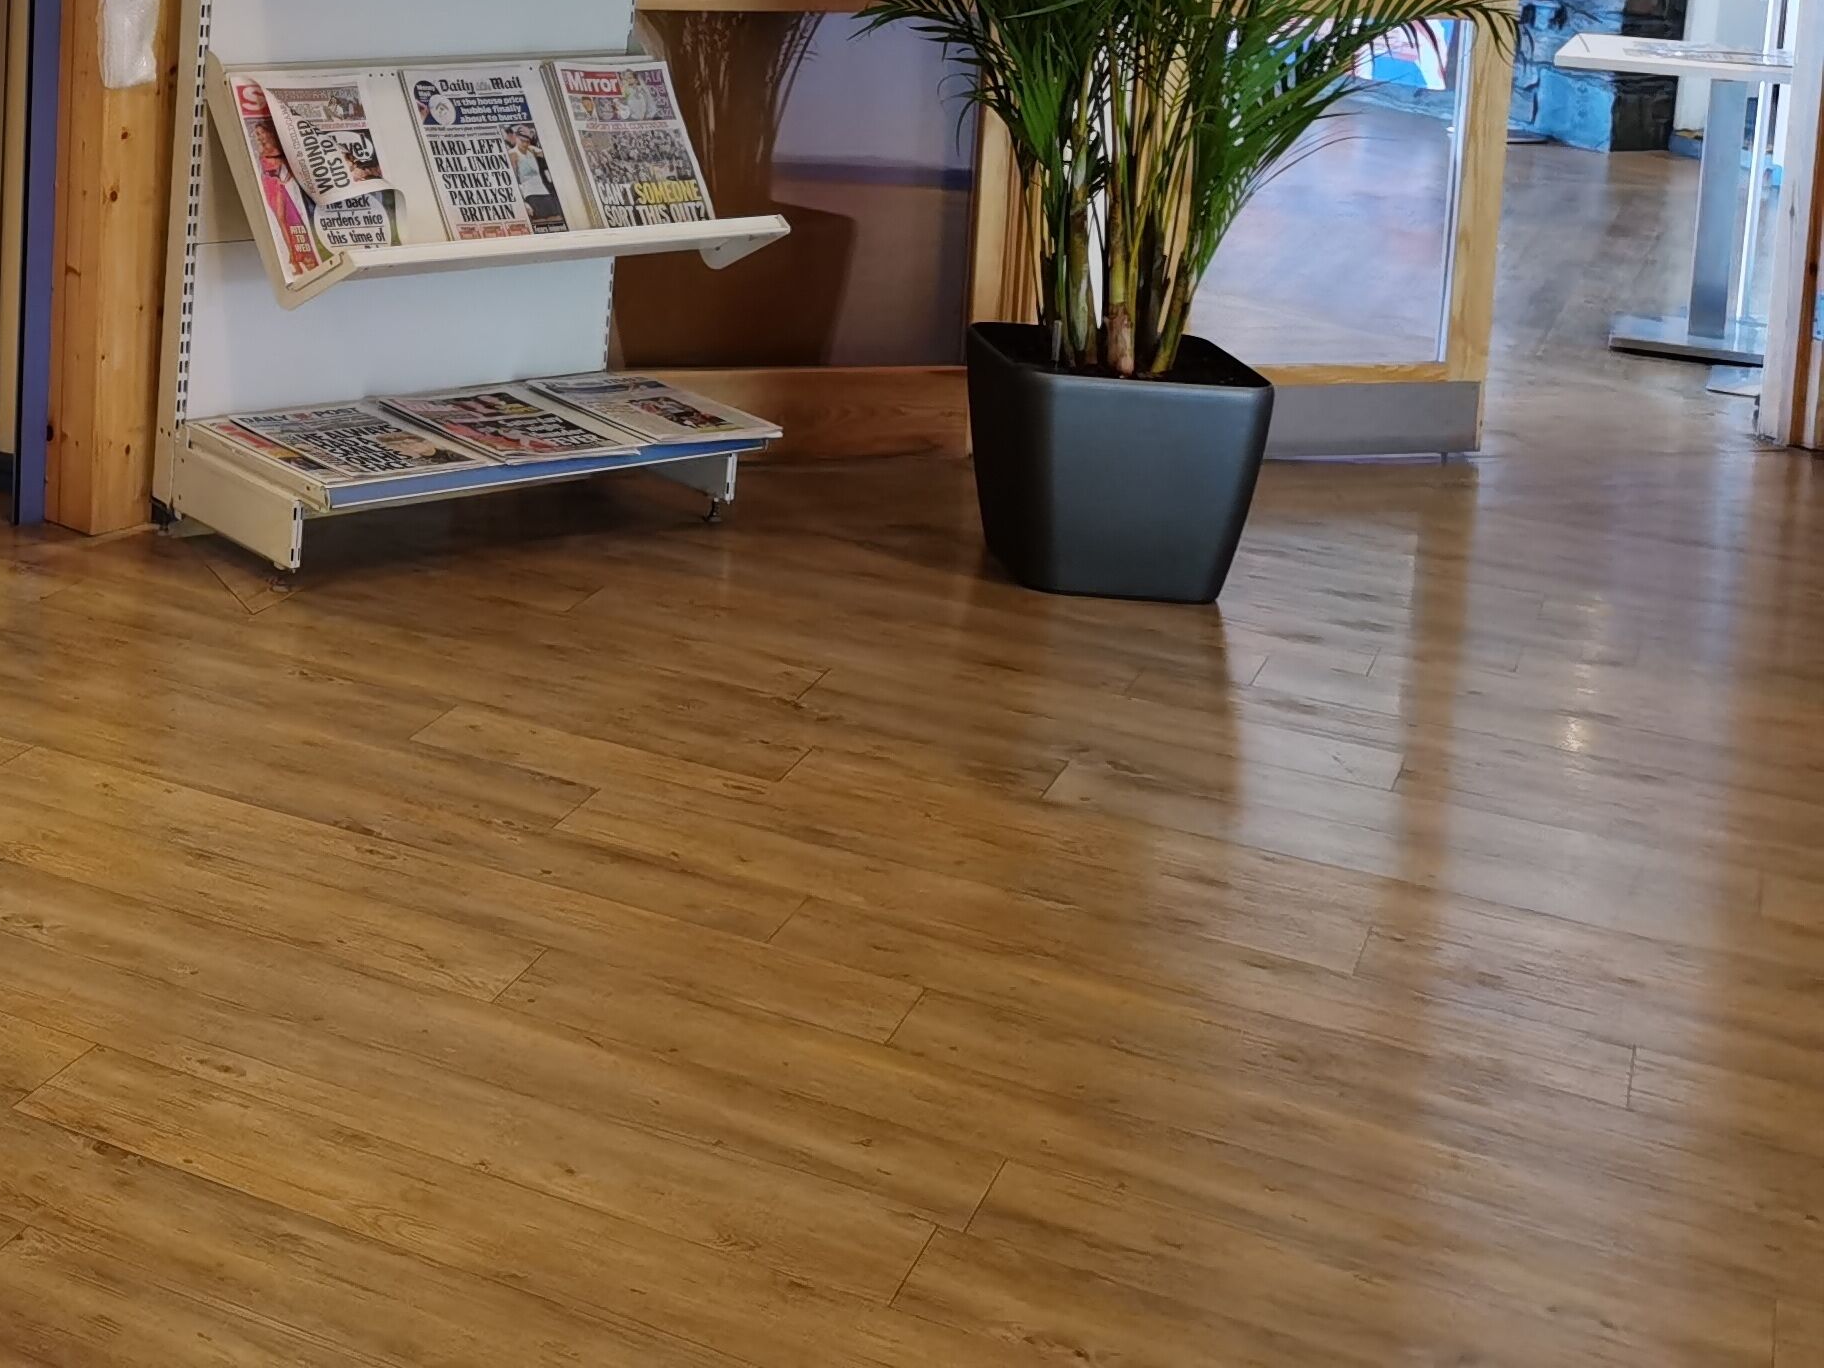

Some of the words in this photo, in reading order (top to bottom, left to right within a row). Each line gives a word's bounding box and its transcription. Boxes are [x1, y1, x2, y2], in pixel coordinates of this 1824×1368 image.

[439, 78, 475, 95] Daily
[489, 76, 522, 91] Mail
[566, 71, 620, 94] Mirror
[461, 105, 492, 115] bubble
[492, 103, 522, 115] finally
[462, 96, 476, 106] the
[477, 95, 502, 105] house
[503, 95, 525, 107] price
[460, 114, 487, 123] about
[488, 113, 498, 123] to
[499, 110, 529, 122] burst?
[429, 137, 504, 156] HARD-LEFT
[296, 119, 335, 195] WOUNDED
[434, 155, 467, 173] RAIL
[468, 153, 511, 172] UNION
[327, 157, 351, 189] CUTS
[442, 172, 492, 190] STRIKE
[493, 170, 512, 187] TO
[449, 187, 516, 206] PARALYSE
[597, 183, 635, 206] CAN'T
[633, 179, 702, 205] SOMEONE
[319, 211, 362, 231] garden's
[363, 210, 384, 226] nice
[459, 204, 516, 223] BRITAIN
[603, 204, 637, 228] SORT
[636, 202, 670, 226] THIS
[670, 201, 709, 223] OUT?
[327, 230, 348, 245] this
[350, 229, 373, 244] time
[375, 228, 386, 242] of
[239, 414, 289, 425] DAILY
[313, 407, 362, 418] POST
[326, 422, 404, 440] ALWAYS
[360, 461, 416, 472] FACE
